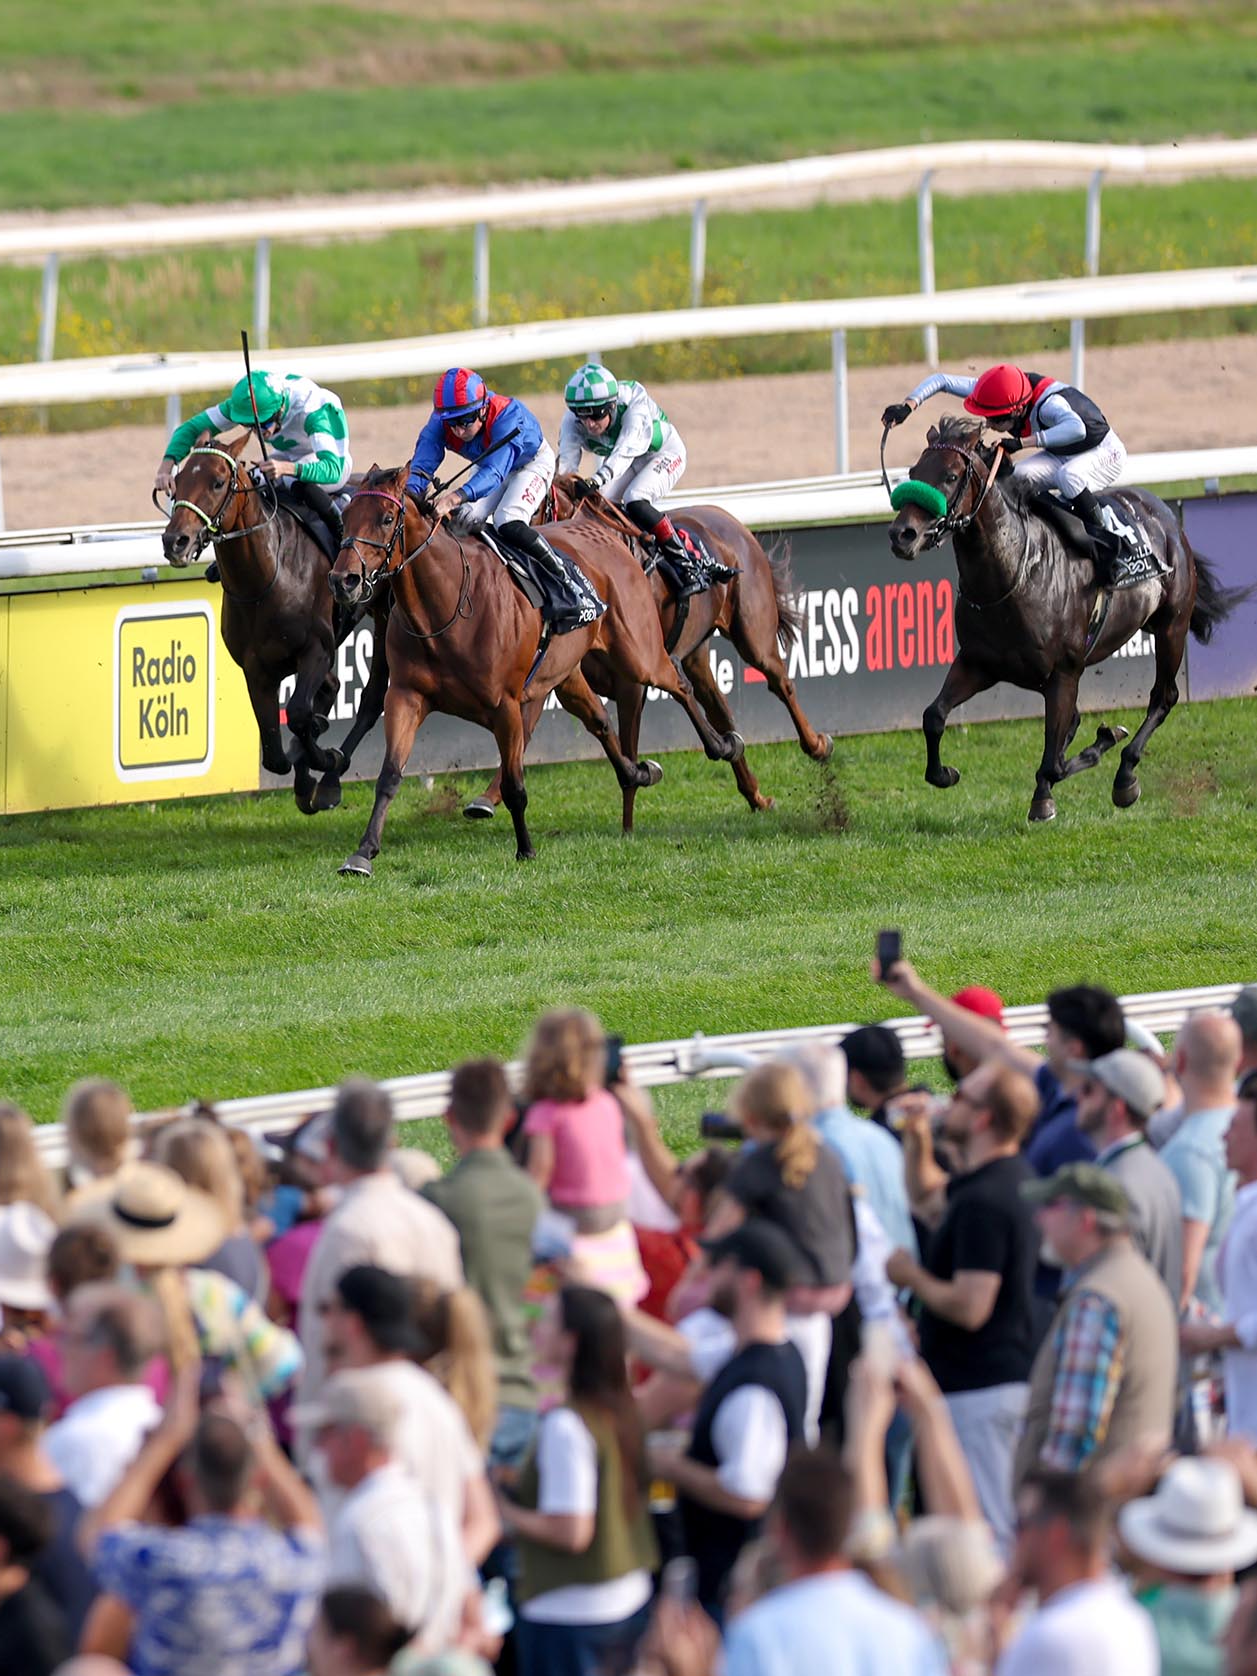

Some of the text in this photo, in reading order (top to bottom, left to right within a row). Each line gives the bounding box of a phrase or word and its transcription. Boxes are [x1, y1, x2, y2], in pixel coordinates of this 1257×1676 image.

[1102, 504, 1138, 545] 4
[1127, 557, 1152, 576] OOL
[780, 586, 860, 680] XESS
[865, 578, 955, 673] arena
[132, 639, 196, 687] Radio
[139, 692, 189, 739] Köln
